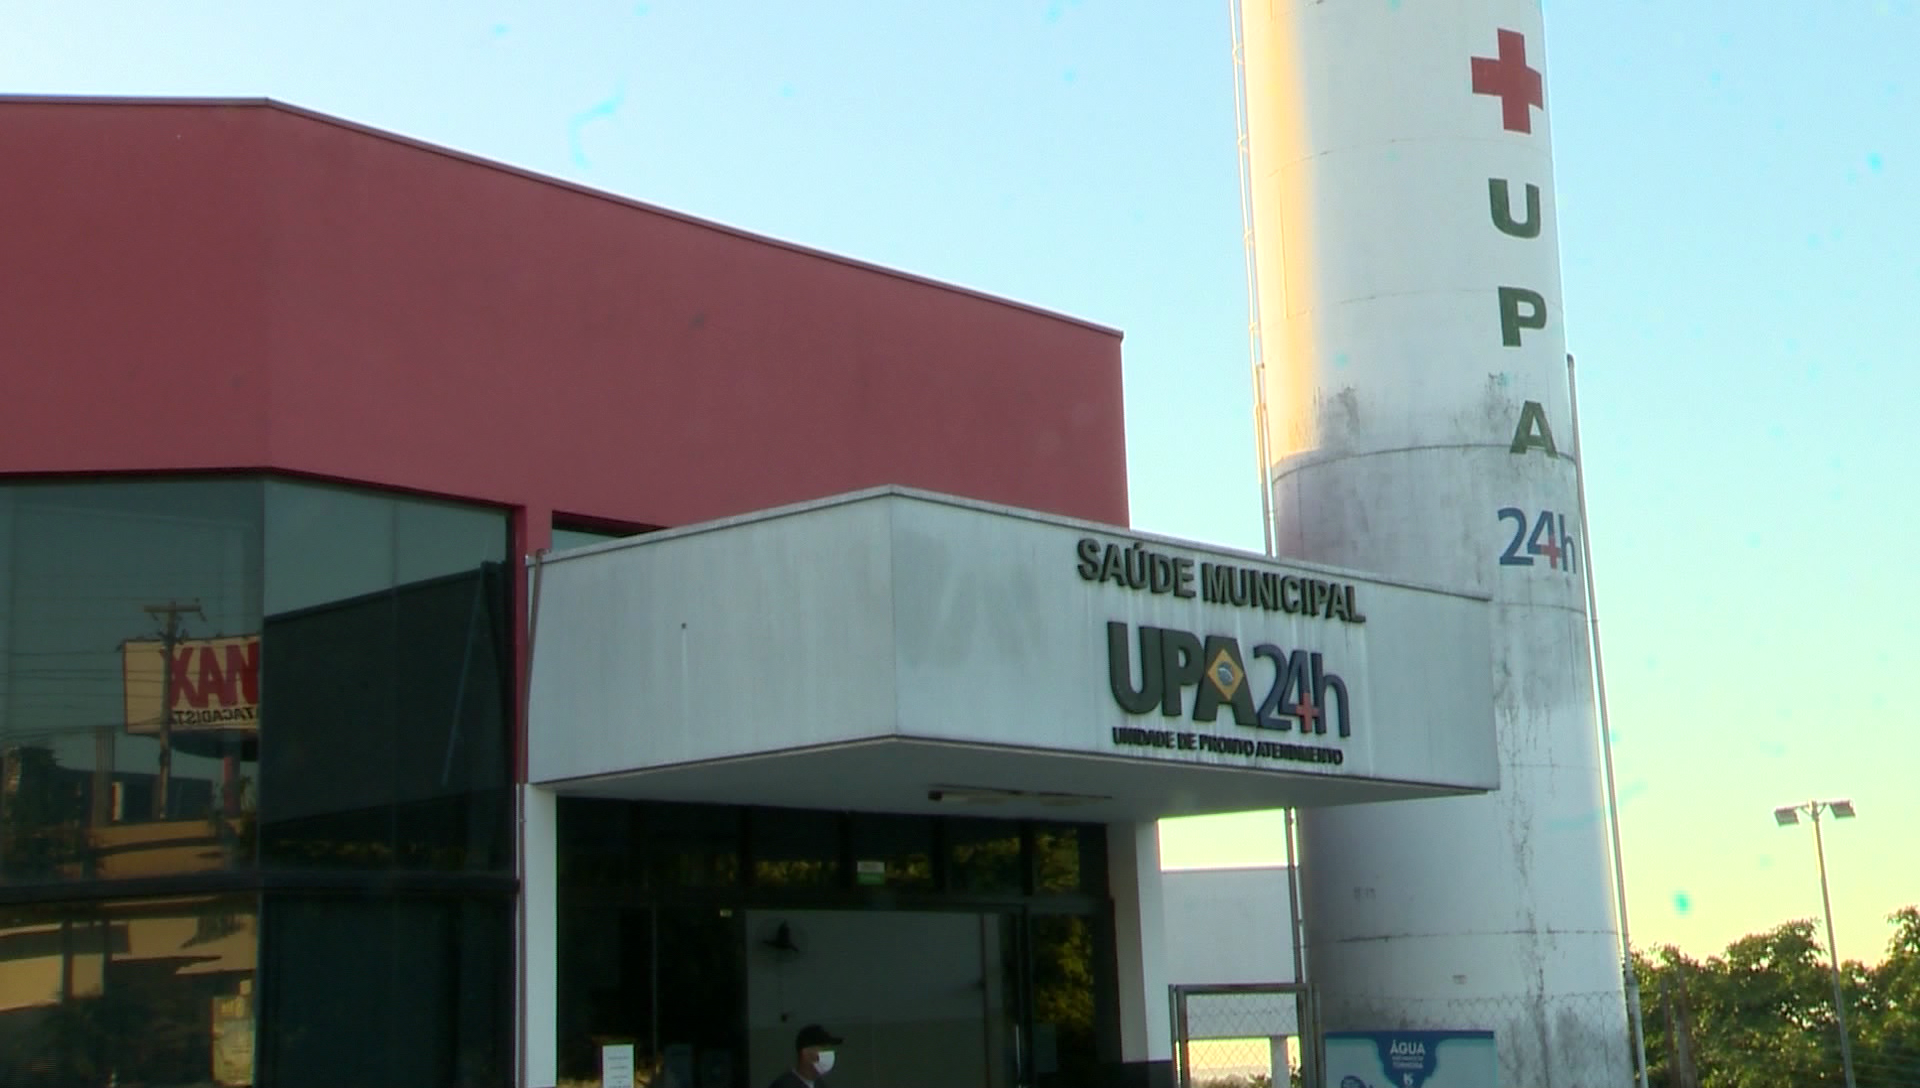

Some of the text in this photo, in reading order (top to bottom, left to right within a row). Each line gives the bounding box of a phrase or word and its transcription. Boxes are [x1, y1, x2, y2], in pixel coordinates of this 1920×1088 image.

[1498, 507, 1576, 574] 24h
[1077, 539, 1366, 623] SAÚDE MUNICIPAL
[1112, 727, 1344, 765] UNIDADE DE PRONTO ATENDIMENTO
[1390, 1039, 1426, 1055] ÁGUA
